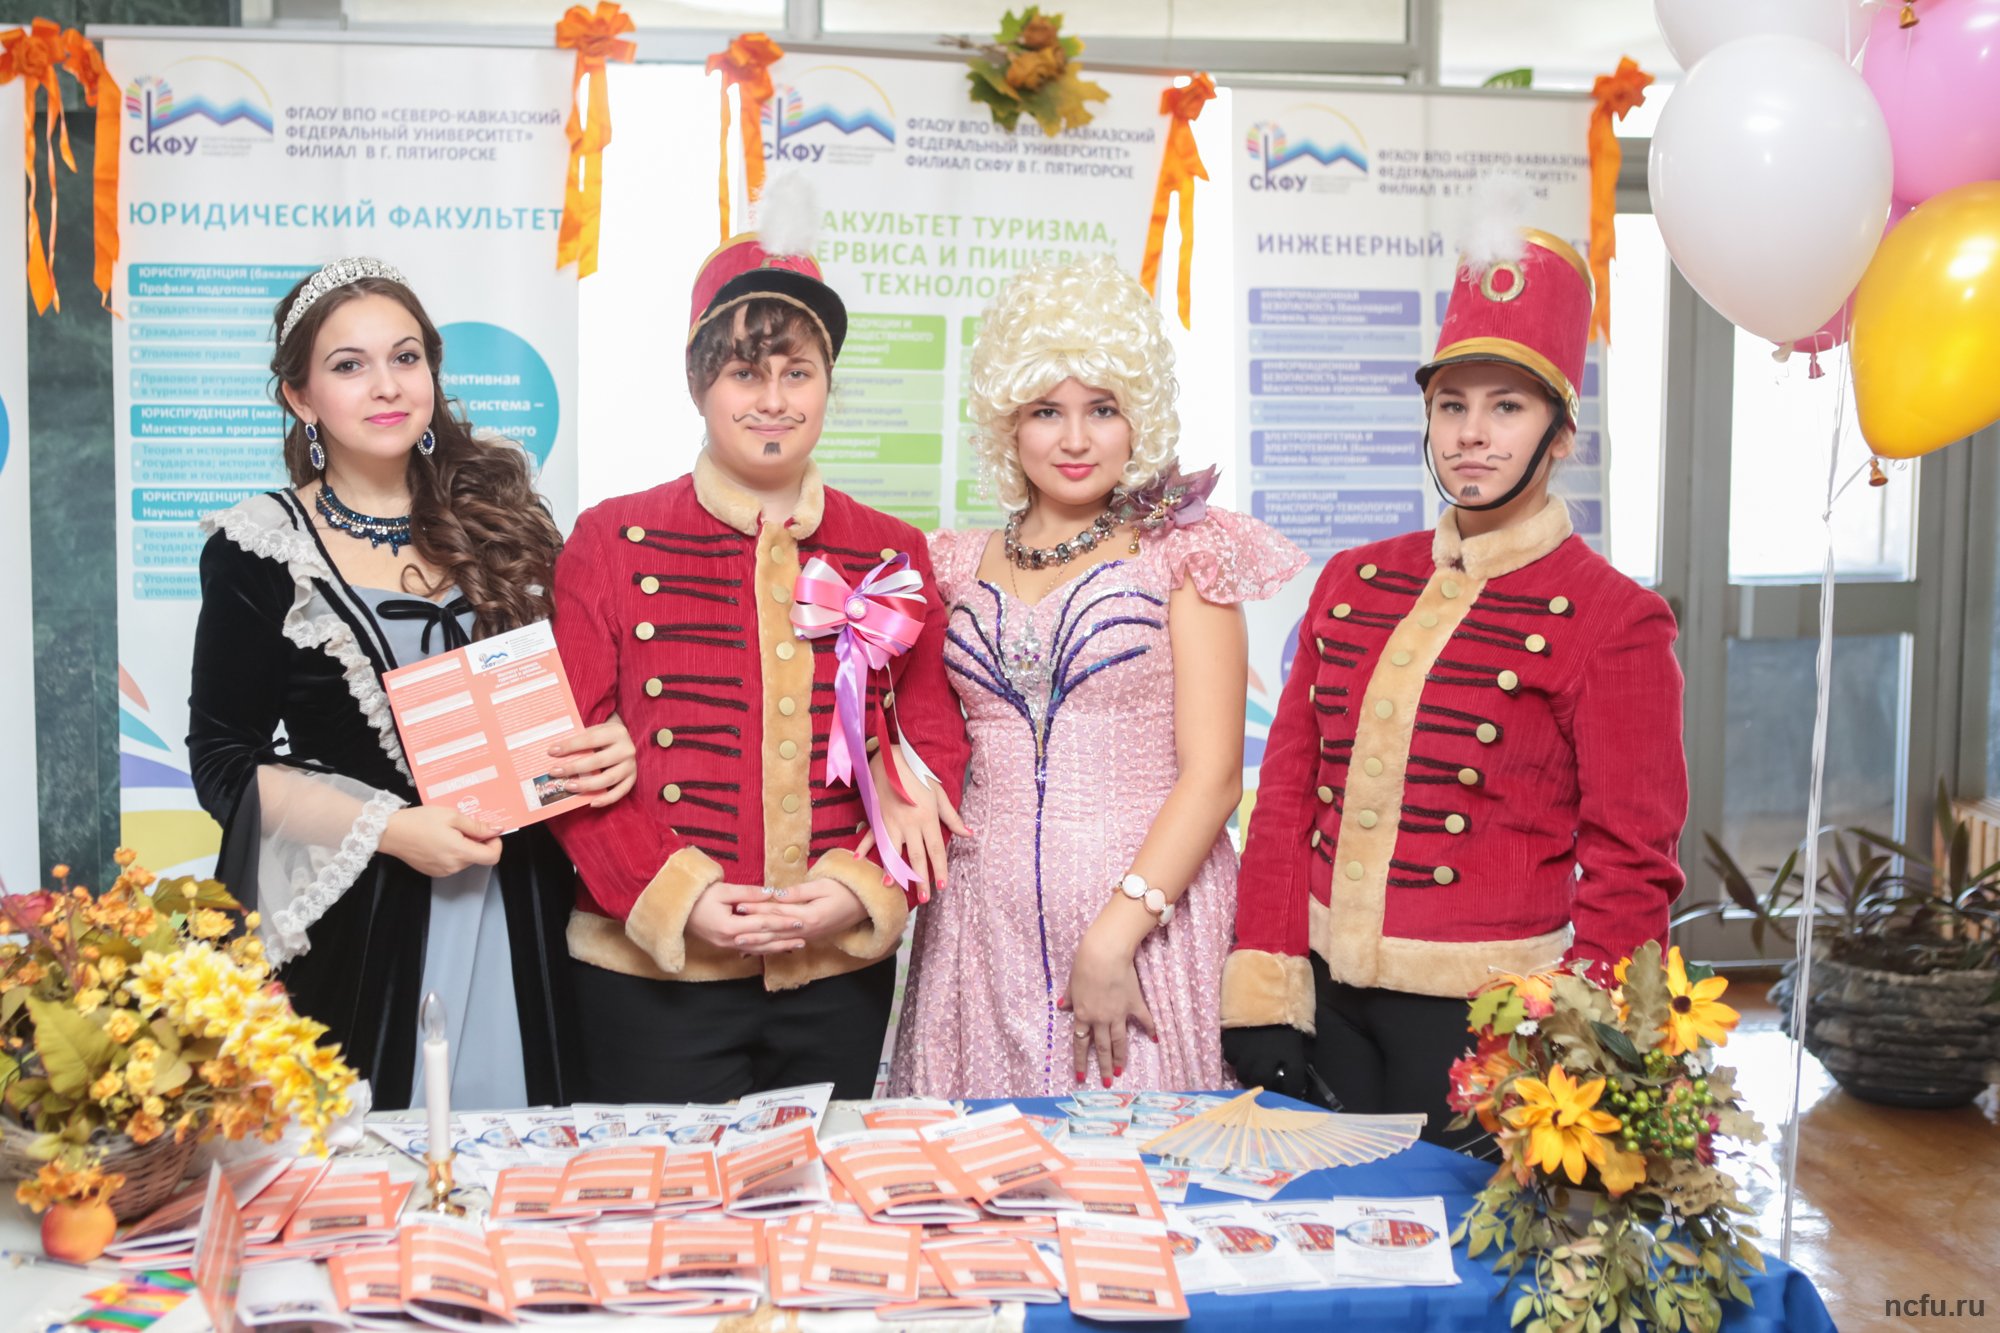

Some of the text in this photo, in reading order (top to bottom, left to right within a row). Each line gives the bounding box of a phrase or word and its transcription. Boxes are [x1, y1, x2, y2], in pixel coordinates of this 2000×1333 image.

[285, 106, 561, 125] ФГАОУ ВПО «СЕВЕРО-КАВКАЗСКИЙ
[285, 124, 533, 143] ФЕДЕРАЛЬНЫЙ УНИВЕРСИТЕТ»
[907, 117, 952, 132] ФГАОУ
[958, 120, 990, 134] ВПО
[129, 135, 198, 156] СКФУ
[285, 145, 357, 159] ФИЛИАЛ
[366, 146, 376, 160] В
[380, 146, 392, 160] Г.
[396, 147, 497, 161] ПЯТИГОРСКЕ
[906, 136, 1131, 160] ФЕДЕРАЛЬНЫЙ УНИВЕРСИТЕТ»
[1378, 150, 1420, 163] ФГАОУ
[1424, 151, 1451, 164] ВПО
[905, 154, 971, 170] ФИЛИАЛ
[974, 158, 1014, 174] СКФУ
[1018, 161, 1027, 174] В
[1030, 161, 1041, 175] Г.
[1045, 162, 1134, 180] ПЯТИГОРСКЕ
[1378, 165, 1477, 180] ФЕДЕРАЛЬНЫЙ
[1250, 175, 1308, 192] СКФУ
[1378, 183, 1436, 197] ФИЛИАЛ
[1443, 185, 1450, 196] В
[129, 199, 563, 231] ЮРИДИЧЕСКИЙ ФАКУЛЬТЕТ
[820, 210, 1117, 248] АКУЛЬТЕТ ТУРИЗМА,
[1257, 231, 1445, 258] ИНЖЕНЕРНЫЙ
[816, 240, 928, 267] ЕРВИСА
[939, 245, 957, 268] И
[139, 267, 247, 281] ЮРИСПРУДЕНЦИЯ
[139, 283, 269, 297] Профили подготовки:
[469, 400, 531, 411] система
[142, 408, 248, 421] ЮРИСПРУДЕНЦИЯ
[142, 424, 223, 435] Магистерская
[142, 491, 250, 504] ЮРИСПРУДЕНЦИЯ
[142, 508, 194, 520] Научные
